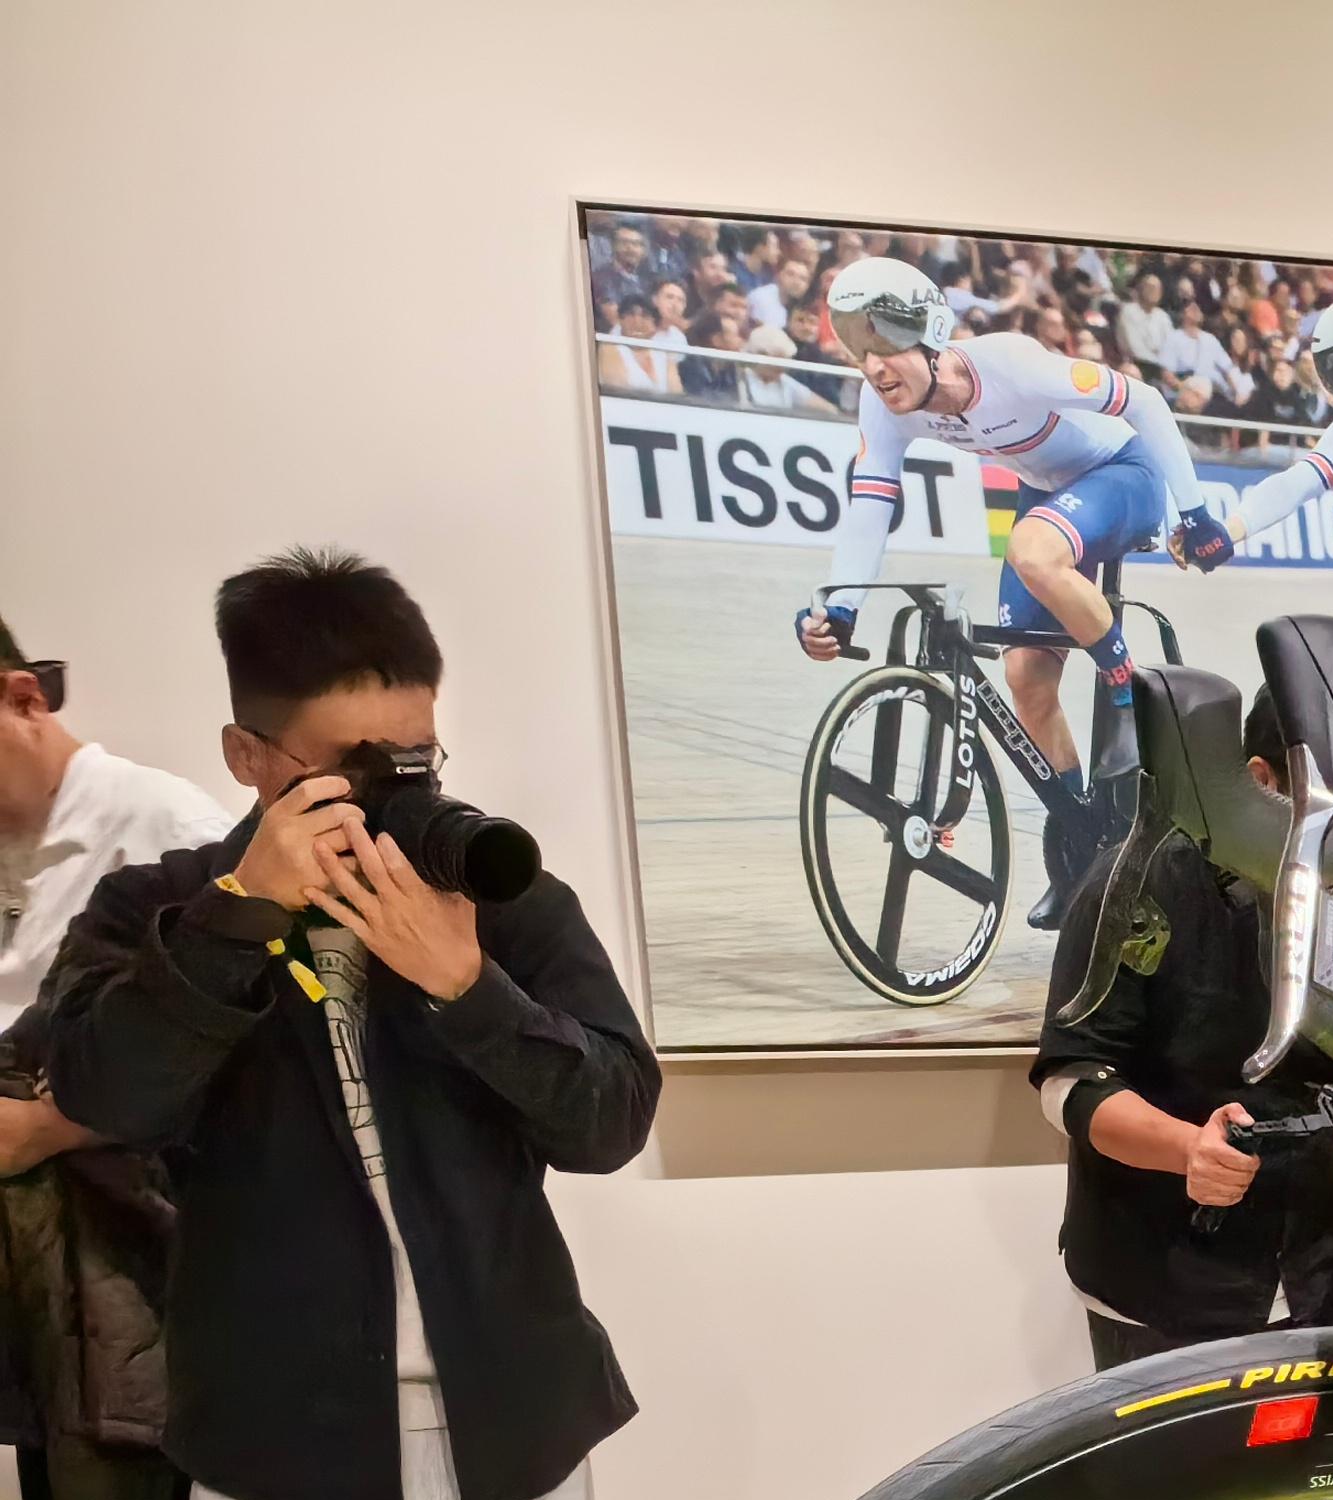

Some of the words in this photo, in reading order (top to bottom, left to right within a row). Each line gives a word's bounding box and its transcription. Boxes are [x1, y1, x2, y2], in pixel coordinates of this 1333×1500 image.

[1195, 537, 1225, 559] GBR
[956, 673, 978, 790] LOTUS
[902, 901, 998, 987] CORIMA
